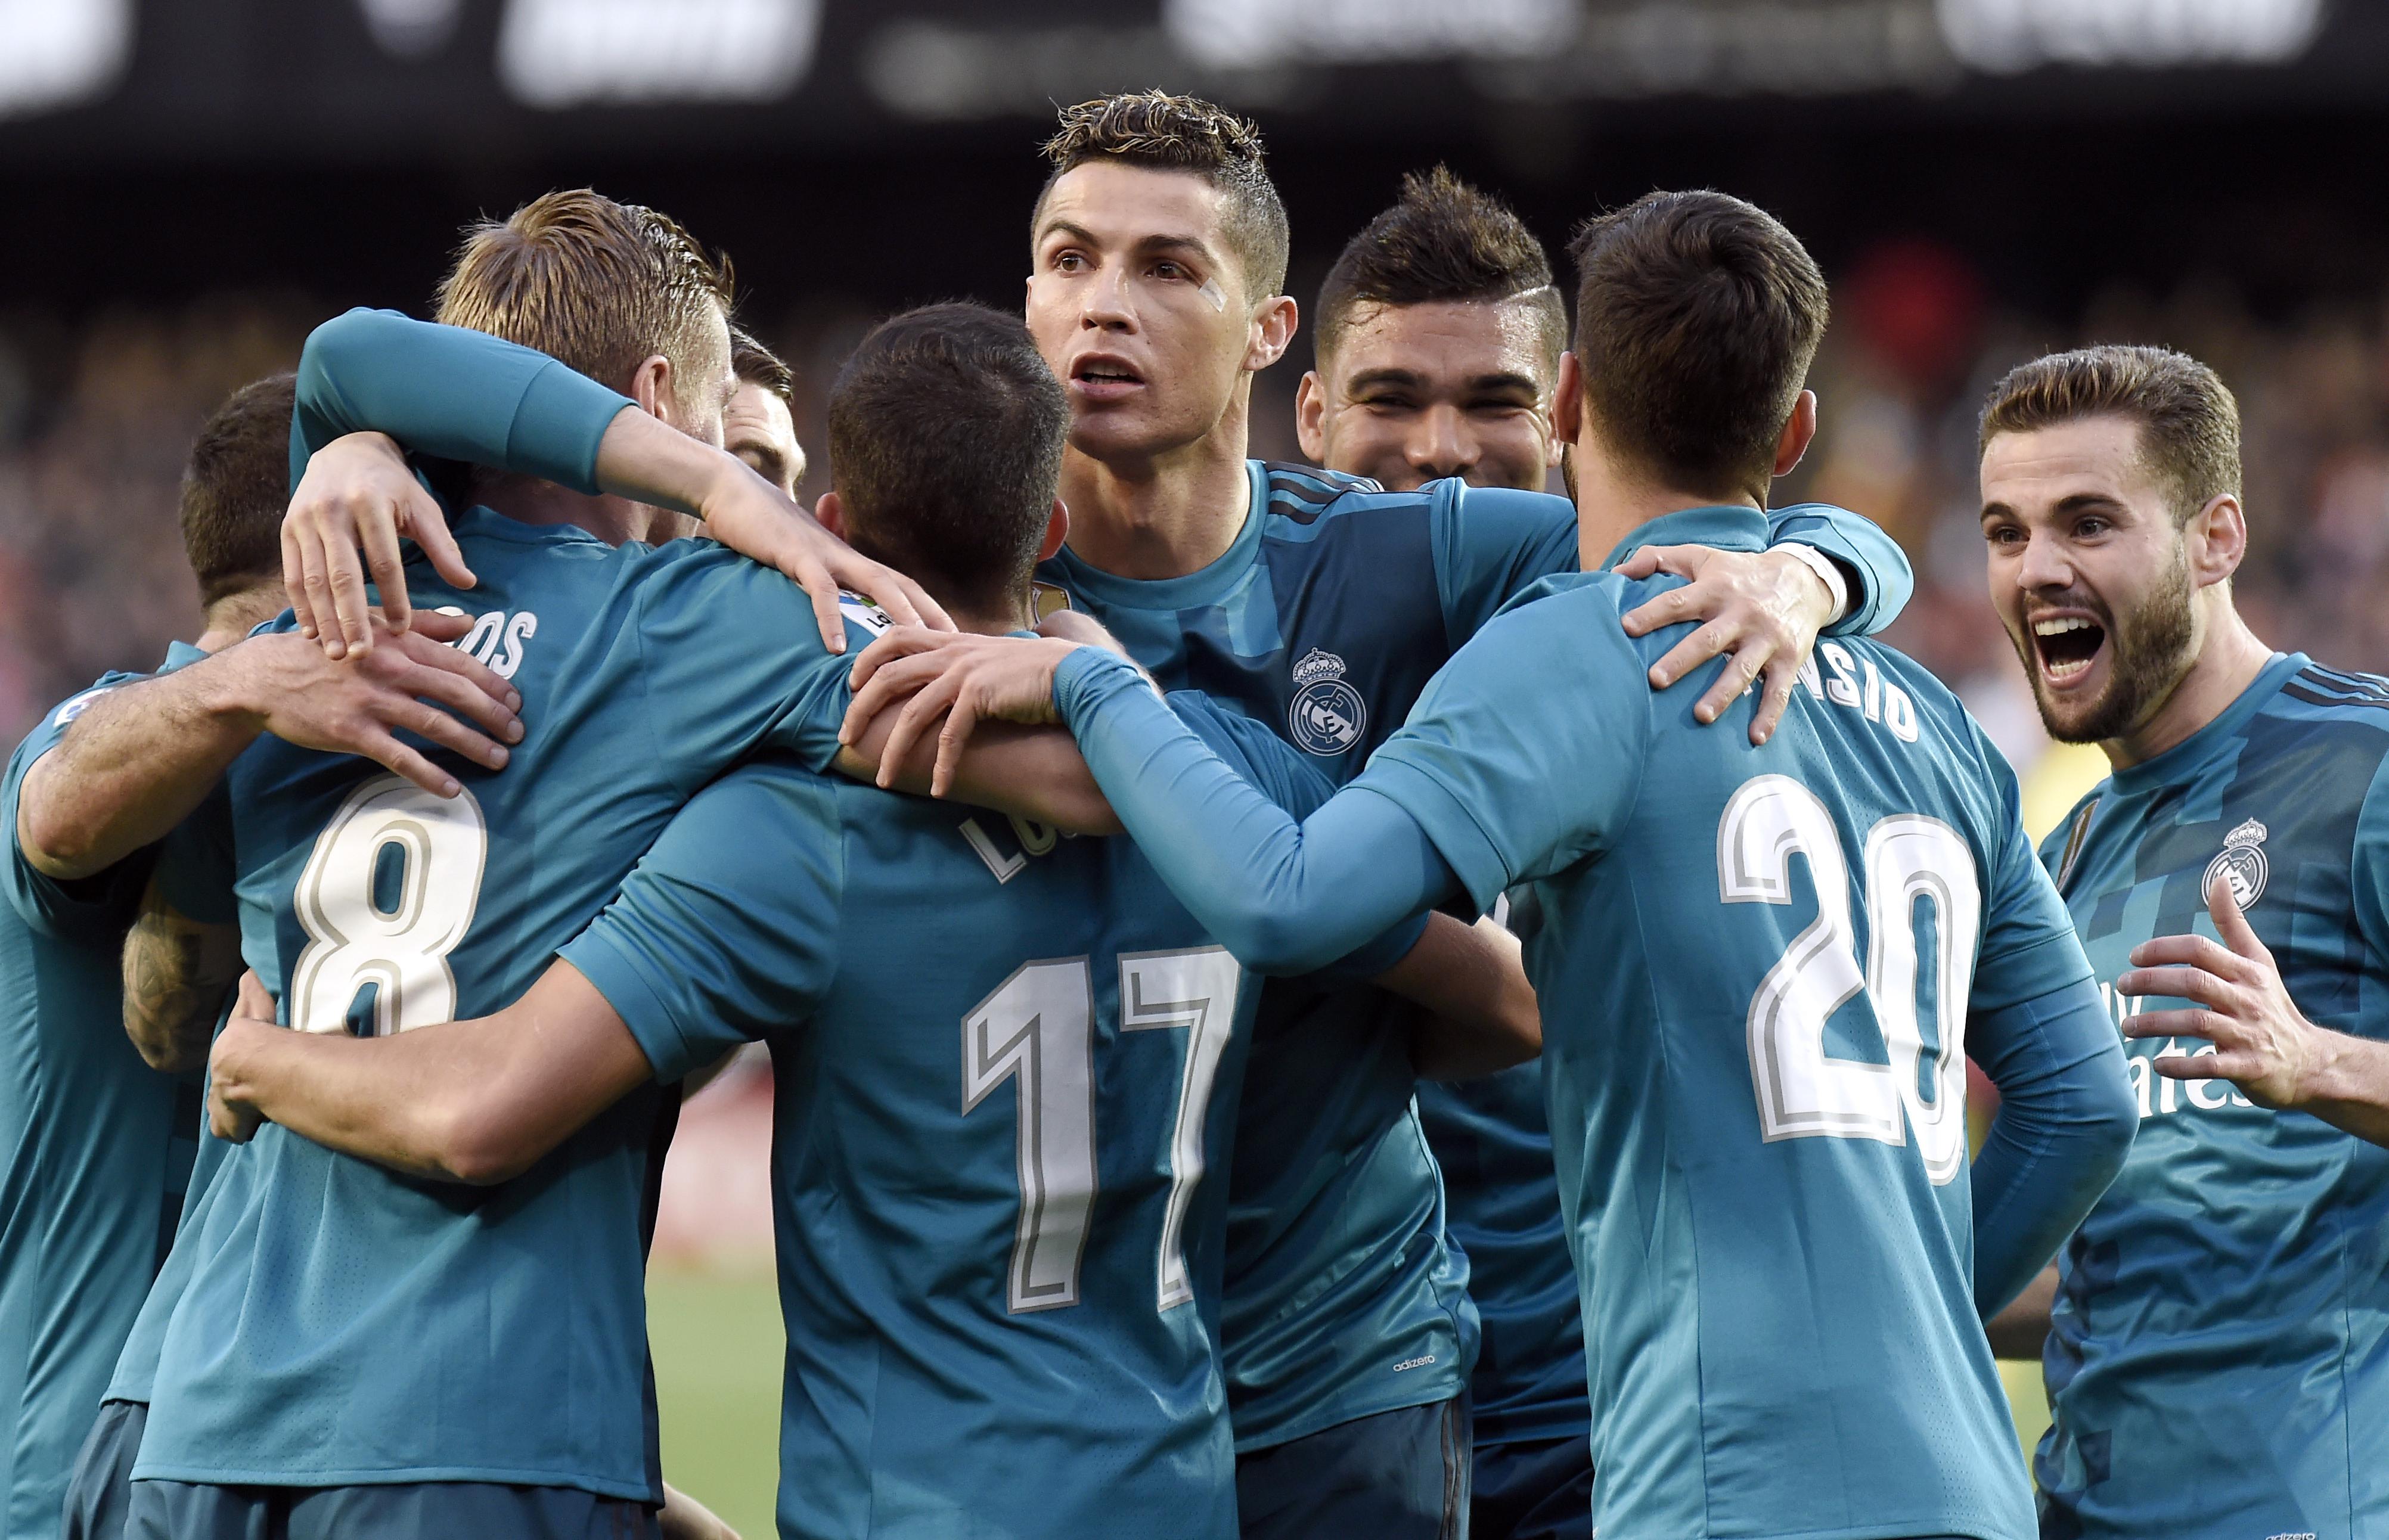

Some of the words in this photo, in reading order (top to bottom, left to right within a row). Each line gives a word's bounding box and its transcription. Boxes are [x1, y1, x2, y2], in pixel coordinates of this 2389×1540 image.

[290, 771, 488, 1038] 8
[1716, 774, 1982, 1186] 20
[961, 944, 1242, 1315] 17
[1392, 1355, 1435, 1372] adizero
